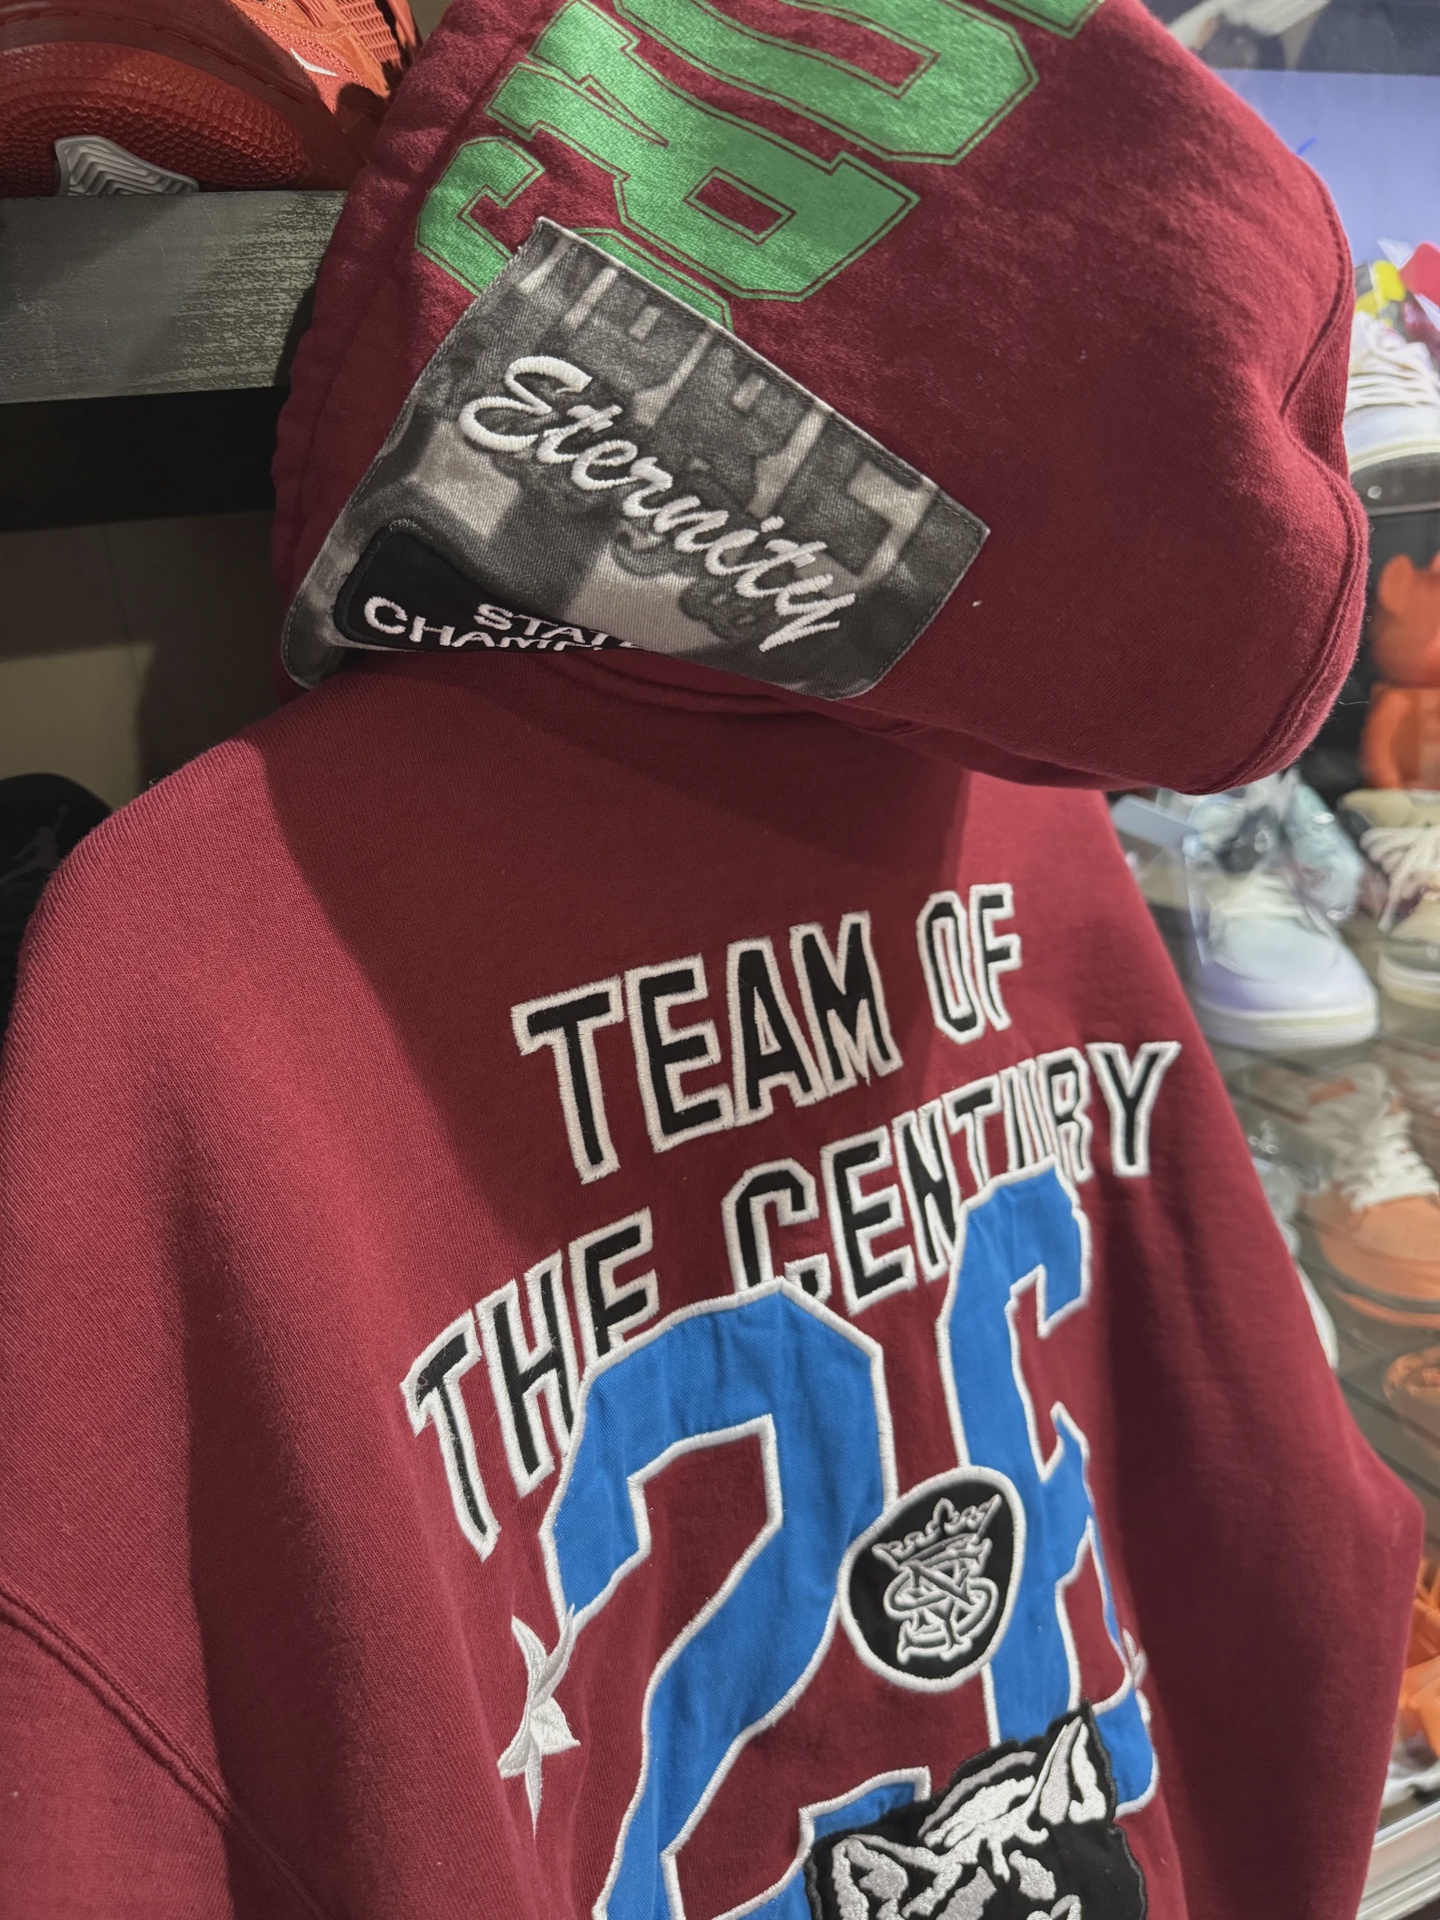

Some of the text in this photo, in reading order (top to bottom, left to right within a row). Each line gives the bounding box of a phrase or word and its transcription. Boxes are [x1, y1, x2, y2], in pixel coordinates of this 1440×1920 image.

[458, 355, 857, 654] Eternity
[511, 883, 1022, 1184] TEAM OF
[400, 1041, 1182, 1562] THE CENTURY
